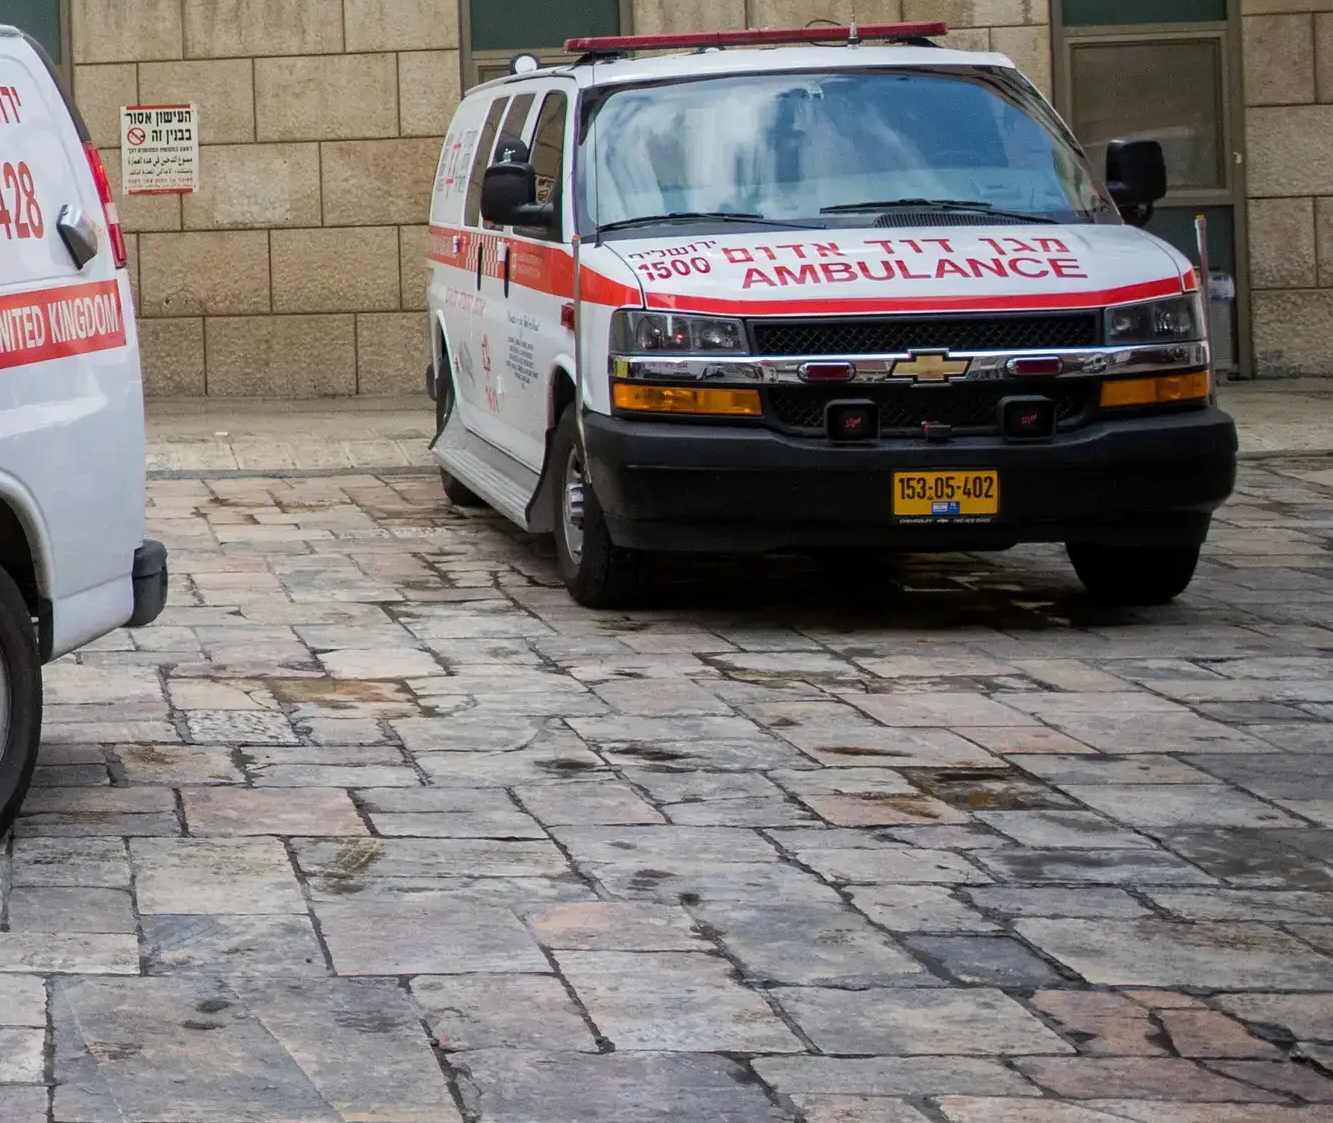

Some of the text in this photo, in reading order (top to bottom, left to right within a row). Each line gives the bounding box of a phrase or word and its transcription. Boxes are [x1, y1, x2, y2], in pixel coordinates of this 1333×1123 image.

[124, 111, 191, 127] העישון אסור
[151, 129, 192, 144] בבנין זה
[721, 237, 1071, 264] מגן דוד אדום
[637, 257, 711, 282] 1500
[742, 257, 1088, 289] AMBULANCE
[47, 293, 118, 343] KINGDOM
[898, 476, 994, 499] 153-05-402
